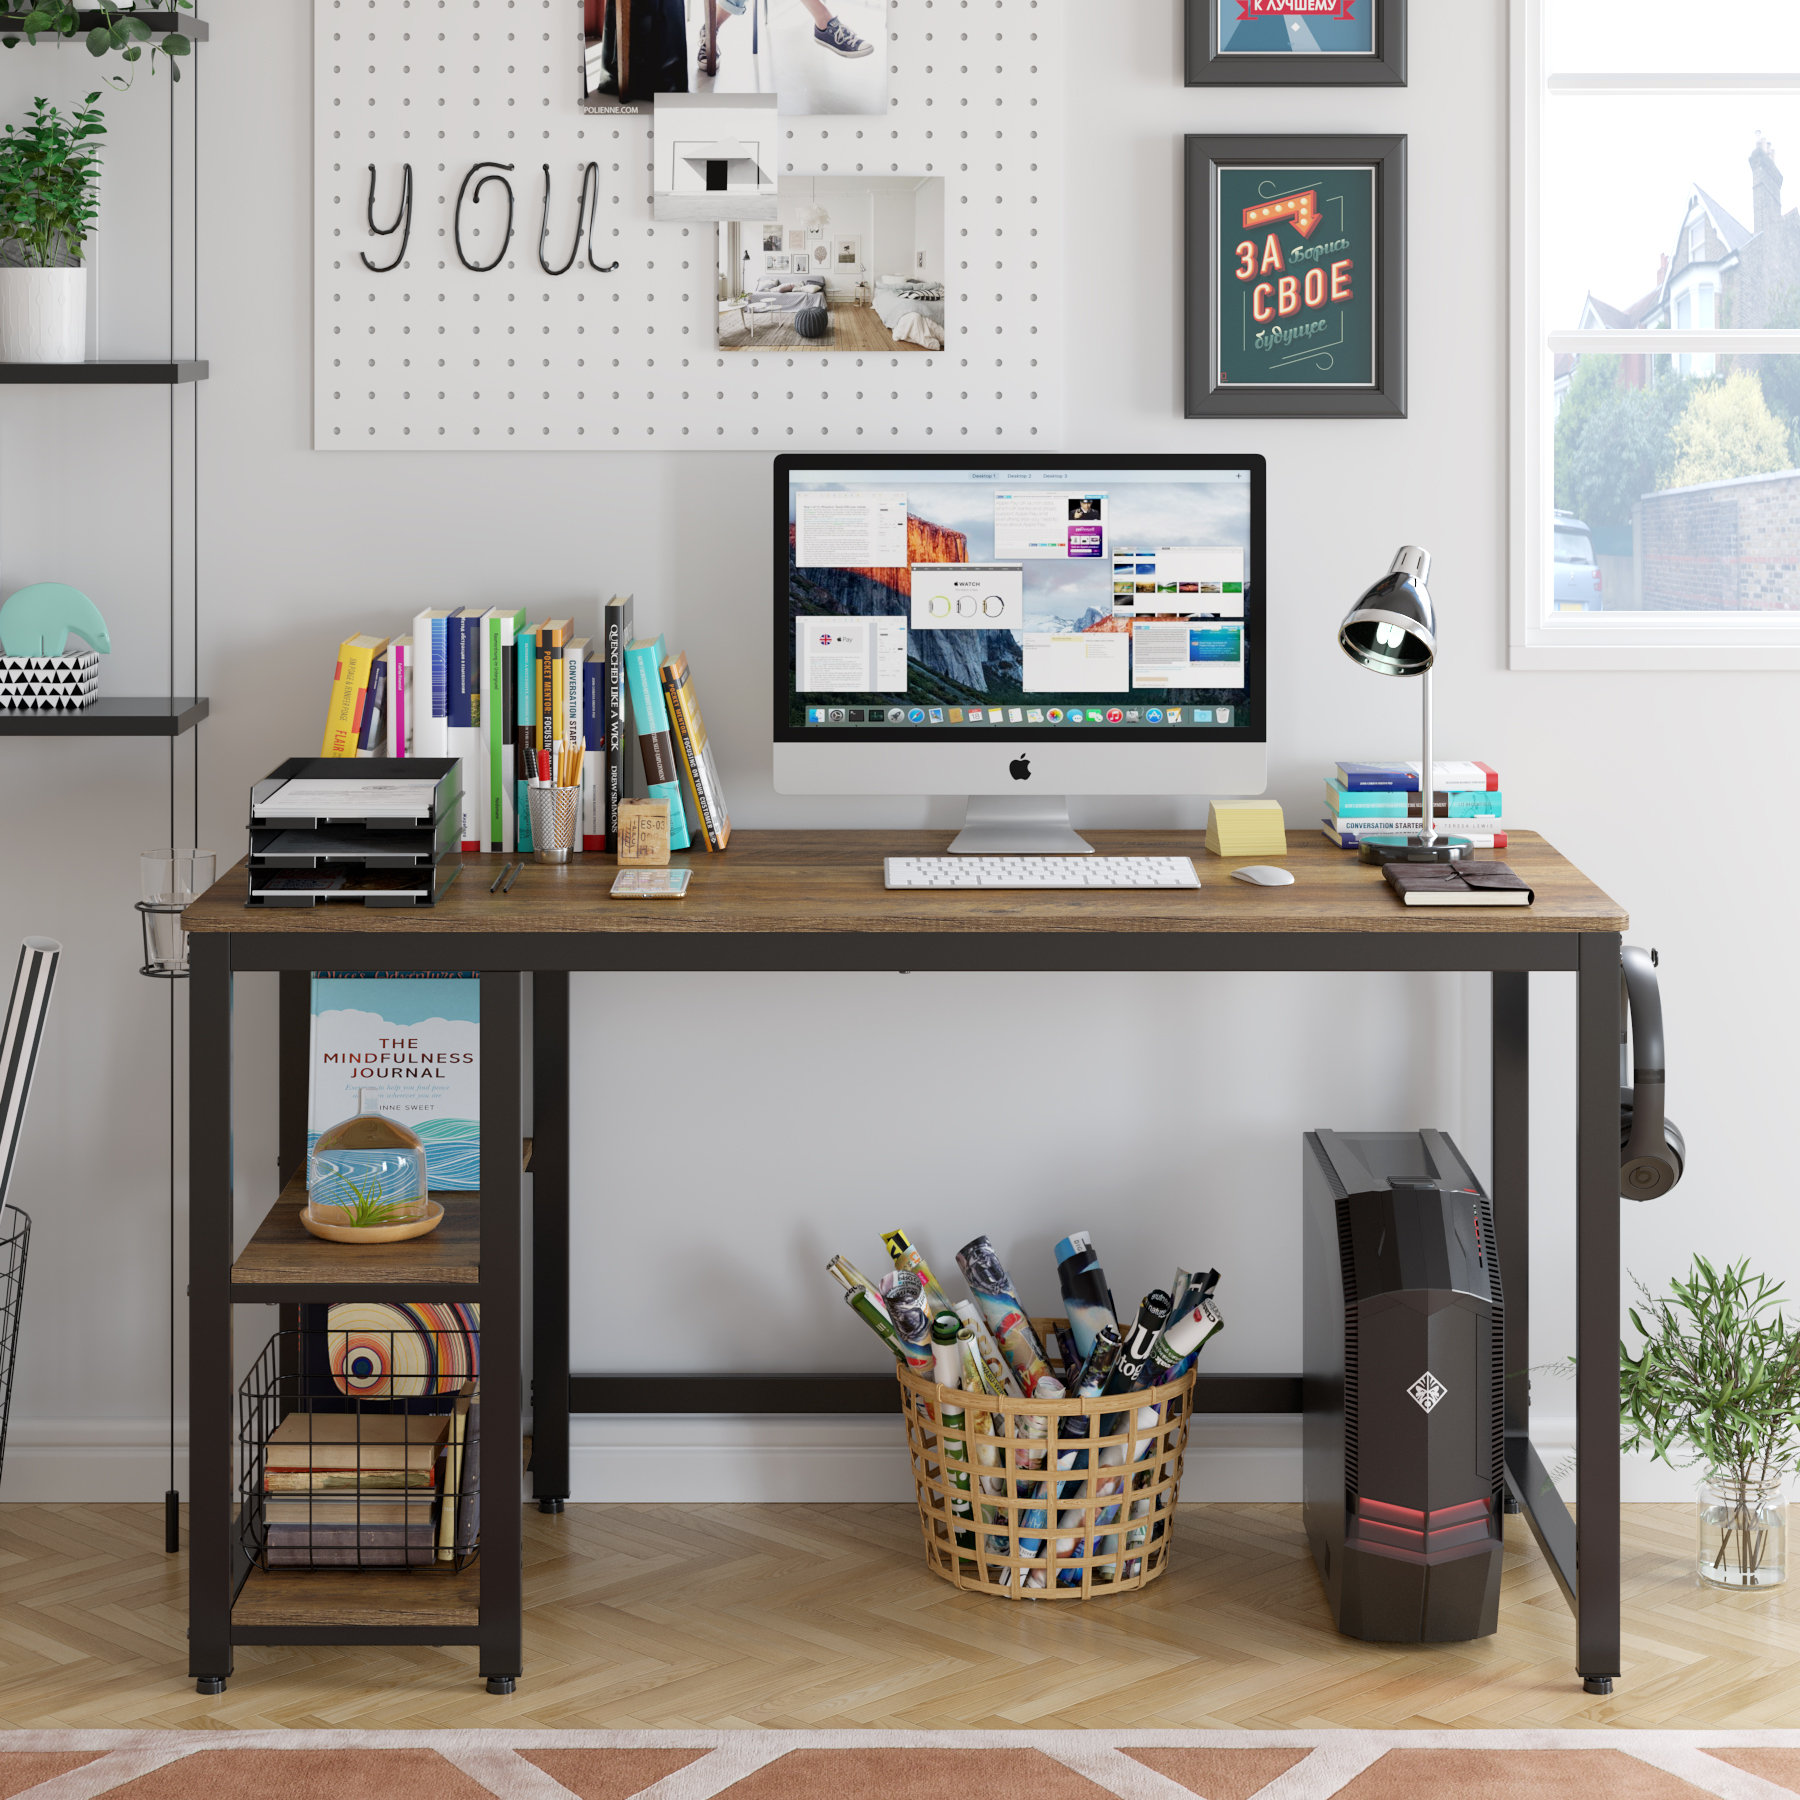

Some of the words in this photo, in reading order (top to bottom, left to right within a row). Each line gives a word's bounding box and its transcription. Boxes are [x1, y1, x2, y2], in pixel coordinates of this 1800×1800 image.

[584, 106, 638, 114] POLIENNE.COM
[1235, 233, 1285, 281] ЗА
[1288, 238, 1350, 264] Борись
[1253, 259, 1354, 324] СВОЕ
[1254, 319, 1328, 351] будущее
[543, 651, 551, 679] POCKET
[609, 624, 618, 684] QUENCHED
[543, 682, 552, 714] MENTOR:
[610, 687, 618, 708] LIKE
[669, 683, 680, 707] POCKET
[611, 710, 618, 718] A
[332, 730, 347, 752] FLAIR
[683, 737, 696, 767] FOCUSING
[692, 769, 699, 777] ON
[695, 779, 703, 796] YOUR
[700, 796, 713, 829] CUSTOMER
[378, 1038, 418, 1049] THE
[323, 1053, 474, 1063] MINDFULNESS
[350, 1067, 446, 1078] JOURNAL
